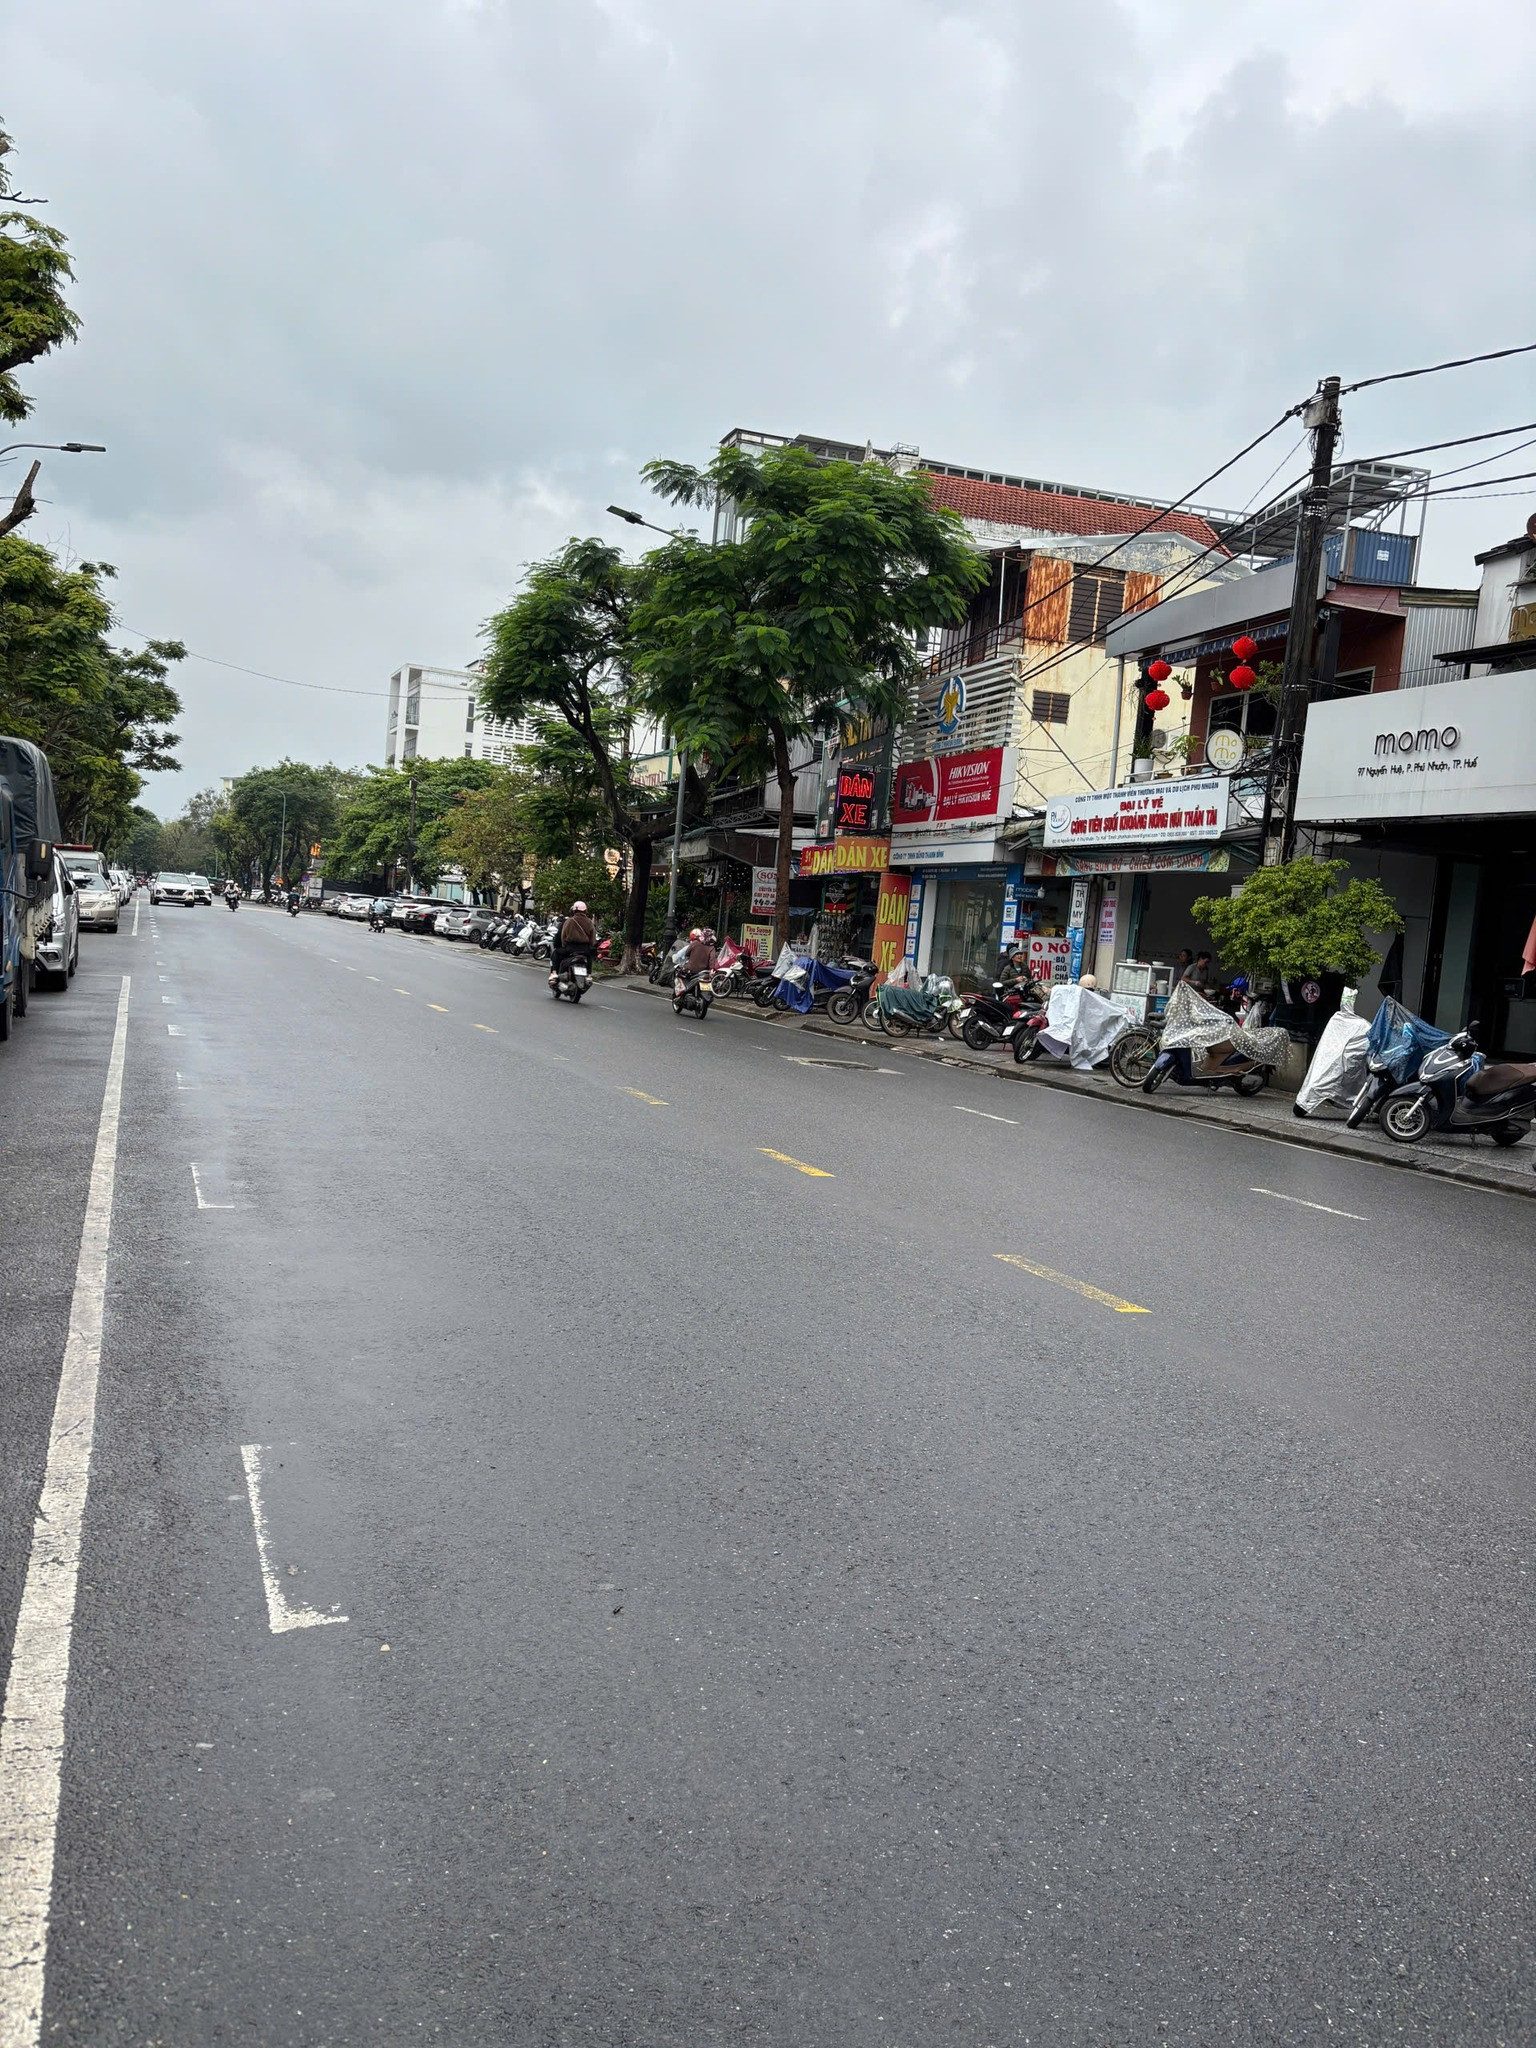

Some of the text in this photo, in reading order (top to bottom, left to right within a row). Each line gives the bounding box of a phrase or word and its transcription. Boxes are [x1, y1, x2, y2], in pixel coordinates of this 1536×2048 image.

[1373, 726, 1460, 756] momo
[948, 761, 992, 780] HIKVISION
[839, 803, 867, 825] XE
[1119, 799, 1136, 813] ĐẠI
[1137, 797, 1150, 810] LÝ
[1070, 816, 1088, 836] CÔNG
[836, 841, 867, 868] DÁN
[870, 846, 888, 868] XE
[879, 886, 908, 926] DÁN
[879, 940, 897, 973] XE
[1032, 941, 1043, 952] O
